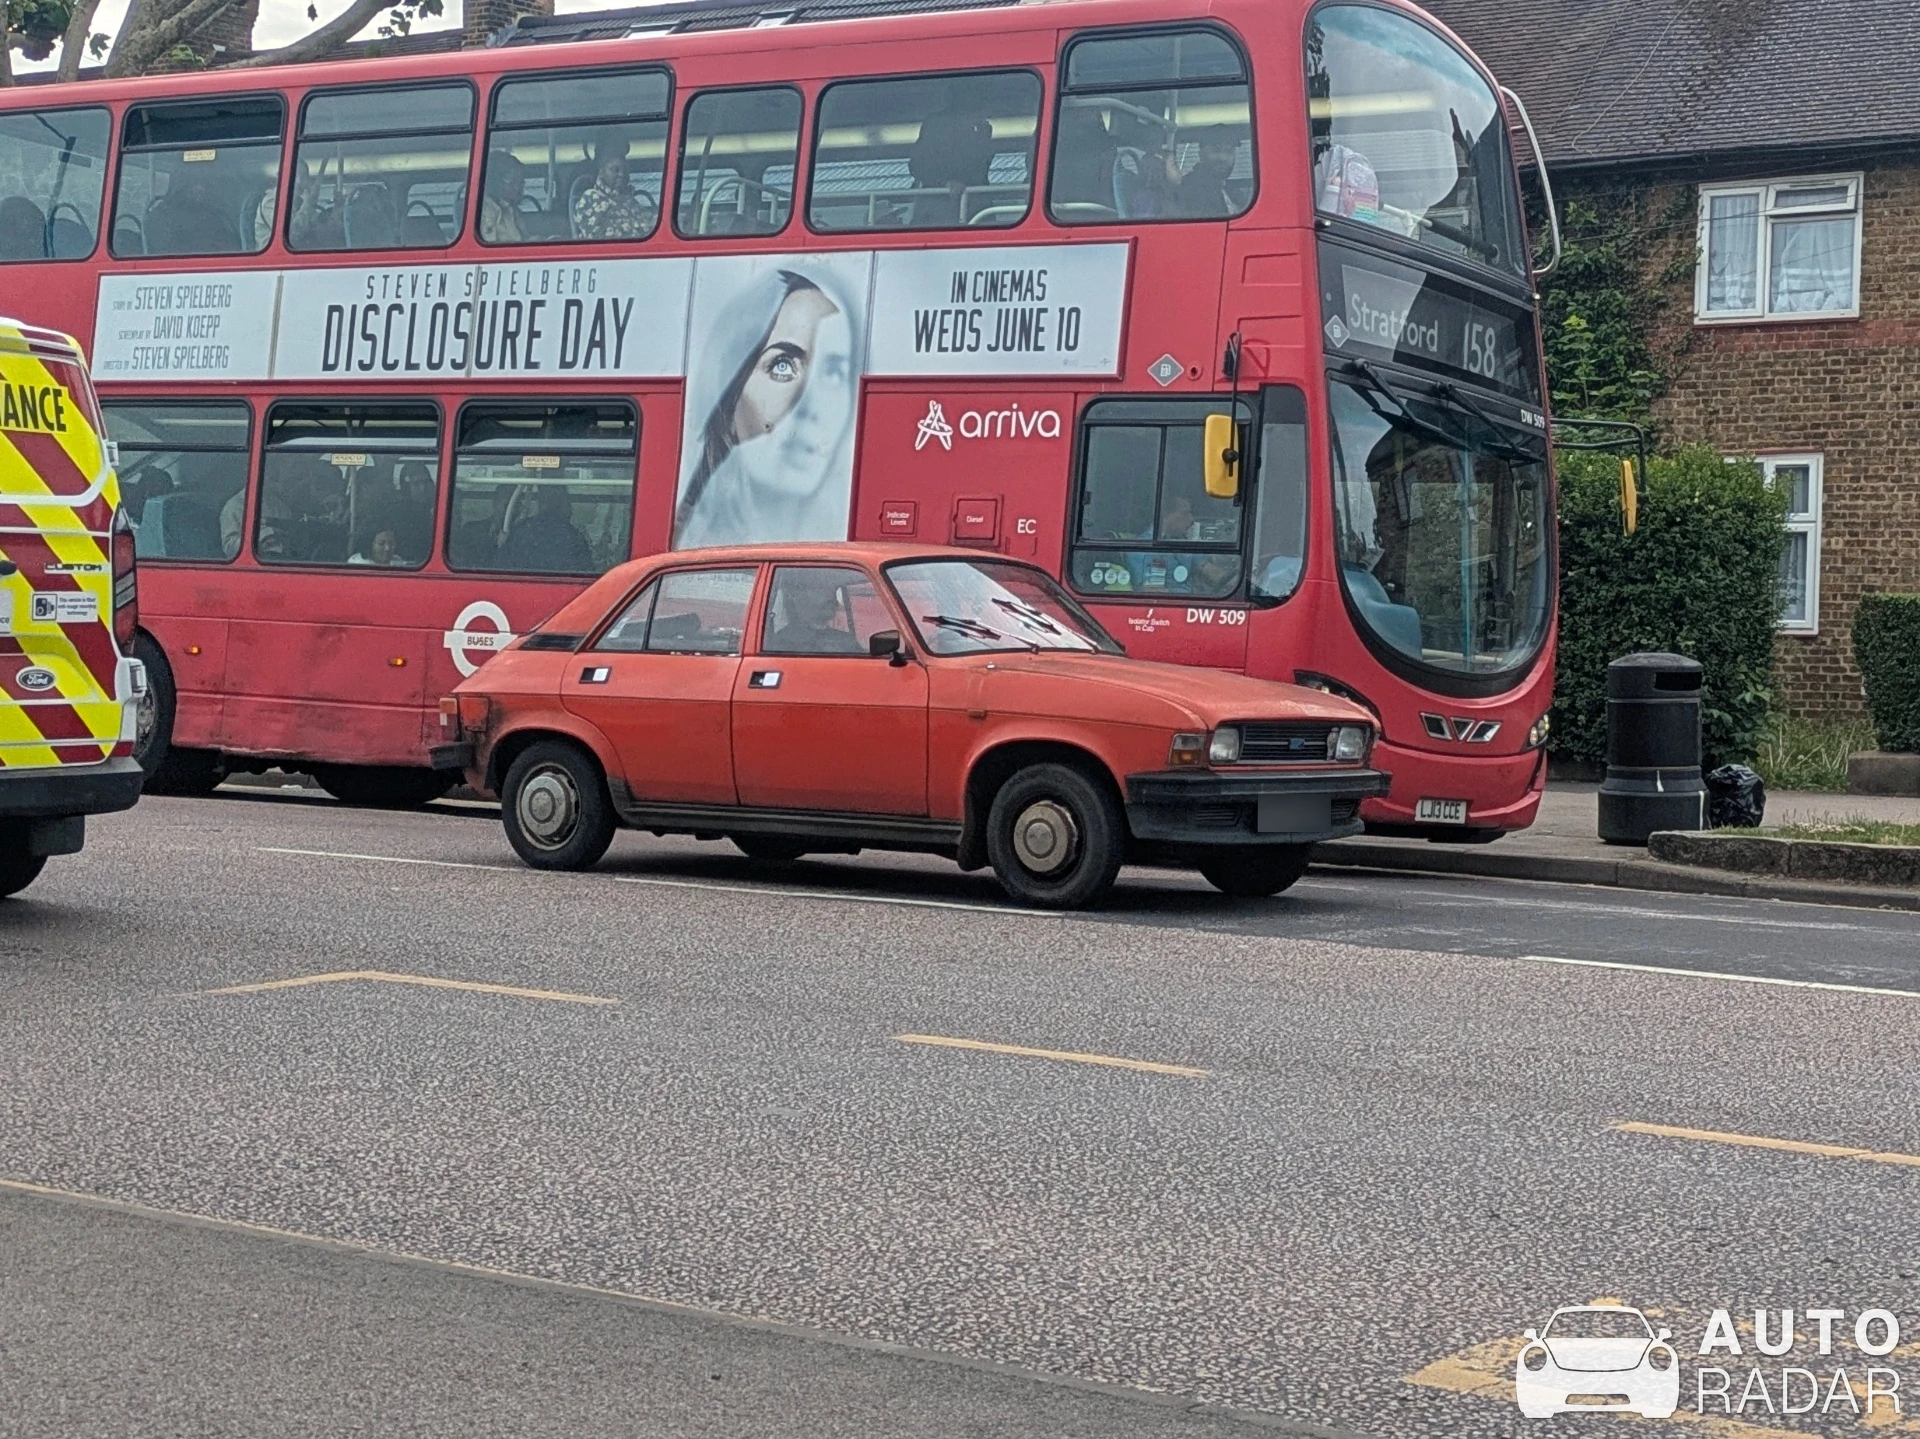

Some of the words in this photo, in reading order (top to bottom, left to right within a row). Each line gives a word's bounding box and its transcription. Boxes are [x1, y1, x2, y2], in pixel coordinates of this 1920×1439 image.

[366, 273, 447, 299] STEVEN
[464, 268, 597, 297] SPIELBERG
[951, 272, 968, 303] IN
[972, 269, 1048, 302] CINEMAS
[135, 286, 173, 310] STEVEN
[176, 284, 232, 309] SPIELBERG
[153, 316, 183, 339] DAVID
[186, 315, 221, 339] KOEPP
[322, 300, 547, 372] DISCLOSURE
[558, 297, 635, 370] DAY
[914, 309, 983, 353] WEDS
[987, 307, 1048, 352] JUNE
[1056, 307, 1081, 351] 10
[1350, 293, 1438, 353] Stratford
[1463, 321, 1496, 378] 158
[132, 346, 170, 370] STEVEN
[173, 345, 230, 369] SPIELBERG
[0, 383, 67, 432] ANCE
[1520, 408, 1533, 425] DW
[1533, 413, 1545, 429] 509
[960, 403, 1061, 438] arriva
[966, 515, 984, 523] Diesel
[1017, 519, 1037, 534] EC
[45, 563, 102, 571] CUSTOM
[1150, 618, 1170, 626] Switch
[1186, 607, 1215, 624] DW
[1218, 609, 1246, 626] 509
[1142, 624, 1155, 632] Cab
[467, 636, 494, 646] BUSES
[26, 673, 49, 685] Ford
[1420, 800, 1442, 819] LJ13
[1443, 801, 1461, 820] CCE
